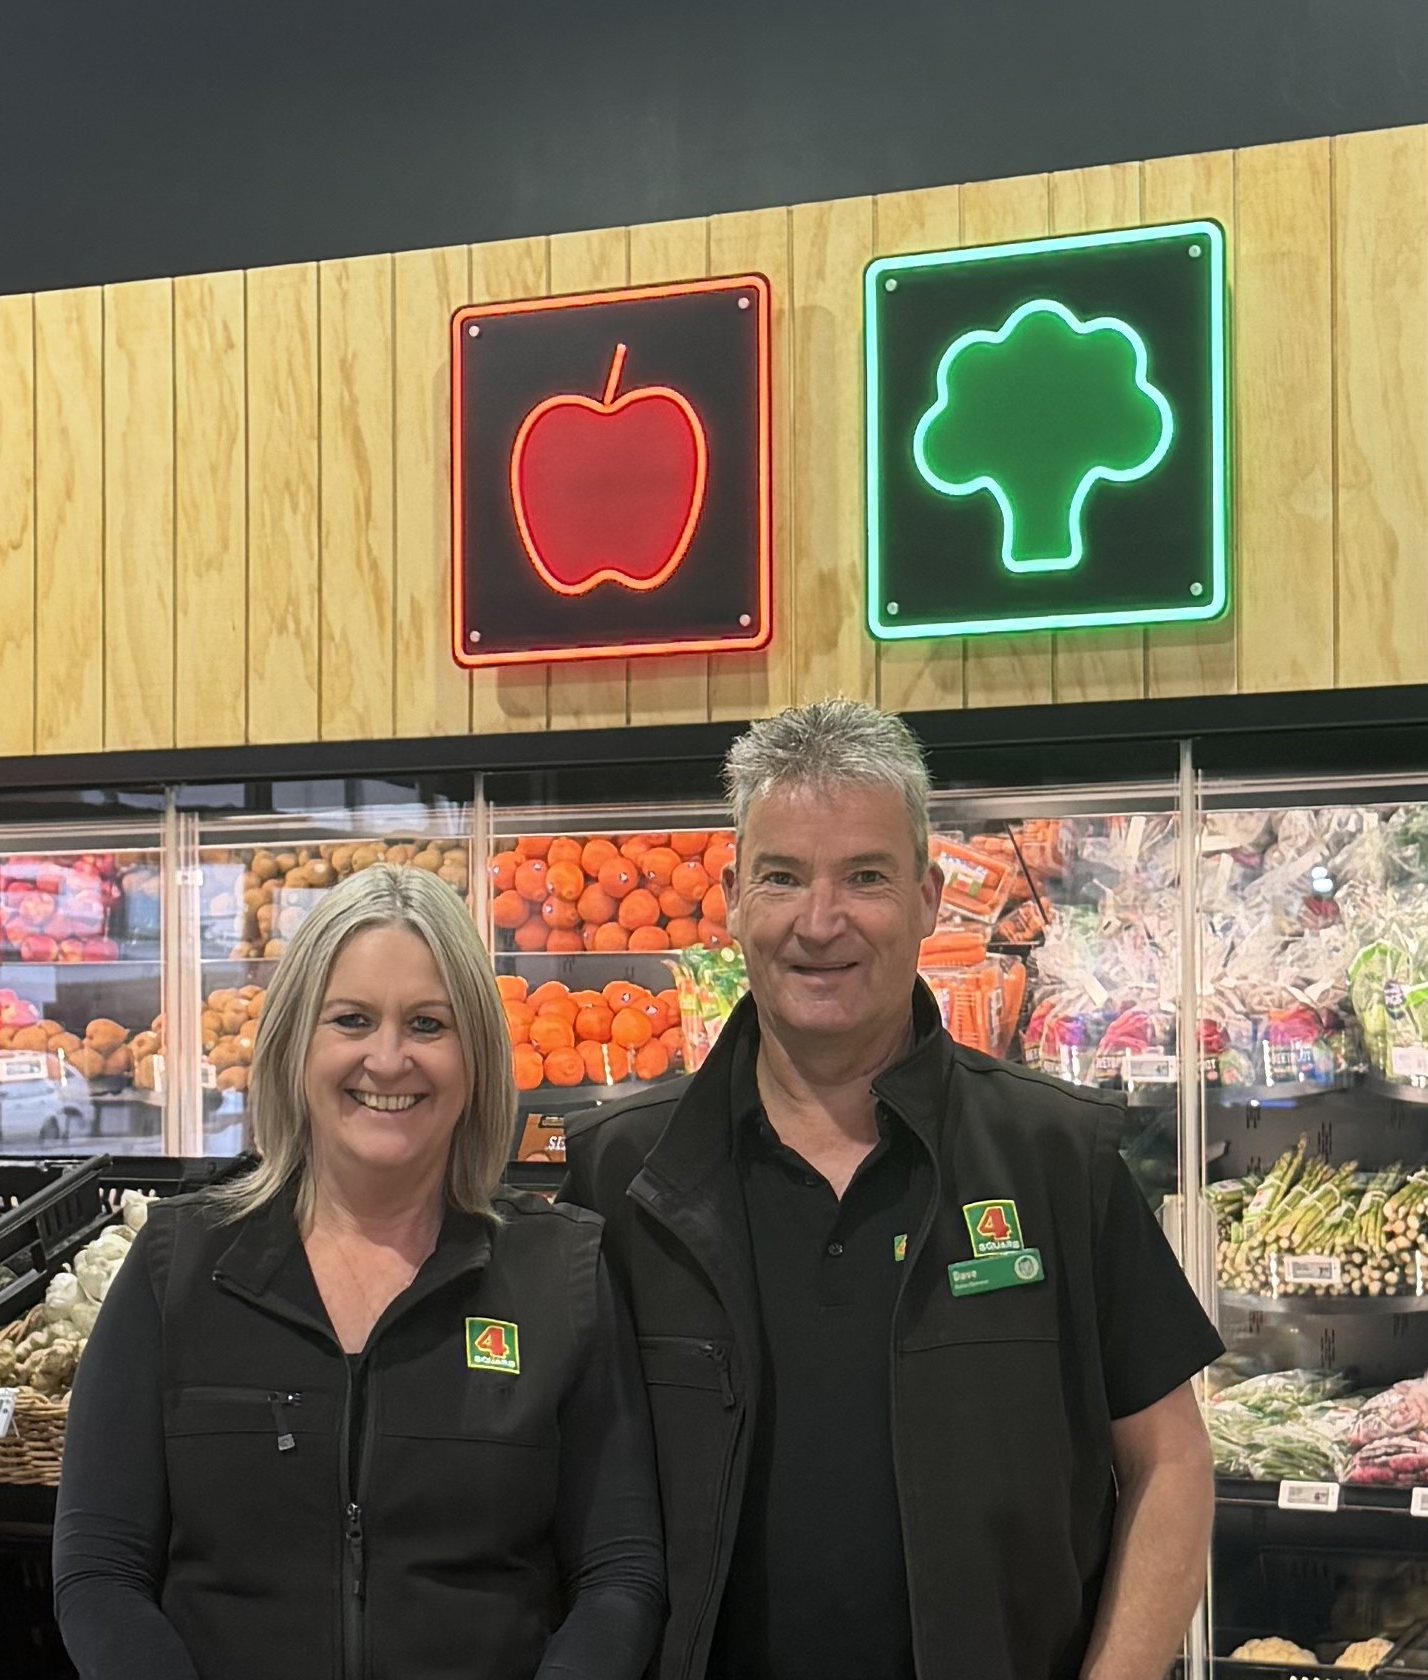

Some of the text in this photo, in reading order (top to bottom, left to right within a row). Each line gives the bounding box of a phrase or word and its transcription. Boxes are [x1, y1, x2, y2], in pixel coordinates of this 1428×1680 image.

[977, 1206, 1012, 1240] 4
[978, 1240, 1020, 1251] SQUARE
[952, 1270, 977, 1281] Dave
[474, 1325, 510, 1360] 4
